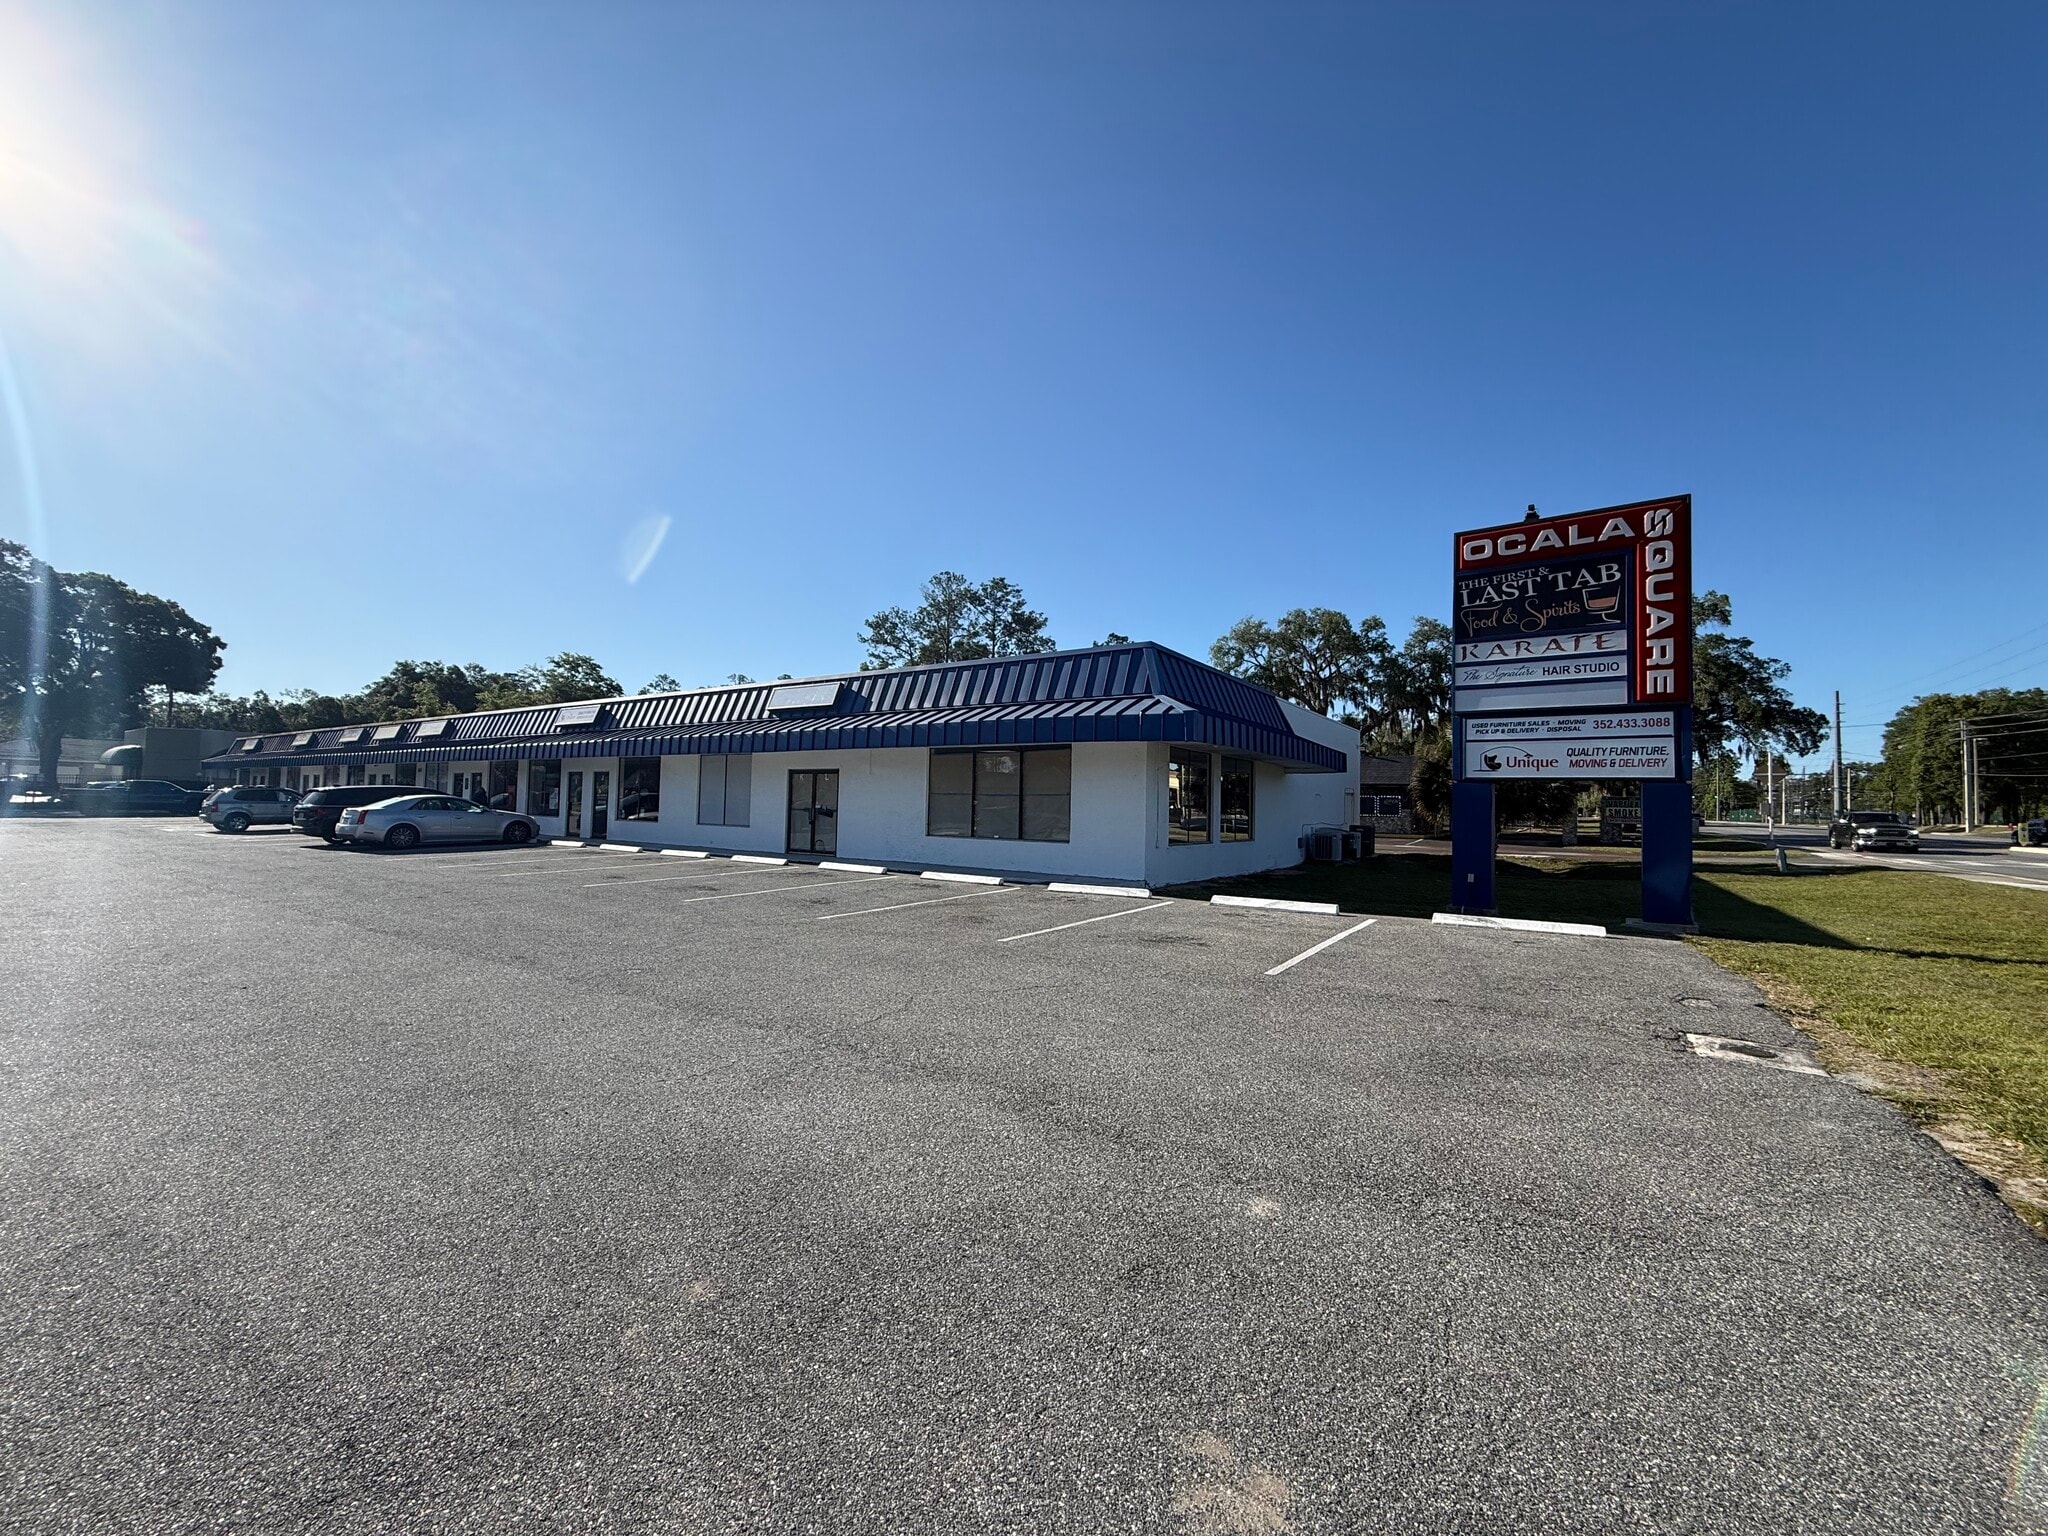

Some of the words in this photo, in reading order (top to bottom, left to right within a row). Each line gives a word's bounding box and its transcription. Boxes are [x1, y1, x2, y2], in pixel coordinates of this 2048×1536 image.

[1463, 517, 1635, 561] OCALA
[1459, 577, 1489, 590] THE
[1493, 568, 1535, 585] FIRST
[1538, 566, 1550, 576] &
[1459, 577, 1541, 608] LAST
[1548, 563, 1622, 592] TAB
[1644, 508, 1674, 694] SQUARE
[1460, 602, 1503, 638] Food
[1502, 607, 1520, 625] &
[1520, 598, 1581, 633] Spirits
[1461, 631, 1617, 661] KARATE
[1463, 668, 1483, 682] The
[1485, 664, 1538, 684] Signature
[1542, 665, 1571, 677] HAIR
[1573, 661, 1620, 674] STUDIO
[1592, 717, 1670, 730] 352.433.3088
[1506, 753, 1559, 772] Unique
[1566, 746, 1608, 757] QUALITY
[1569, 758, 1608, 768] MOVING
[1609, 758, 1617, 768] &
[1618, 758, 1668, 768] DELIVERY
[1608, 808, 1639, 818] SMOKE
